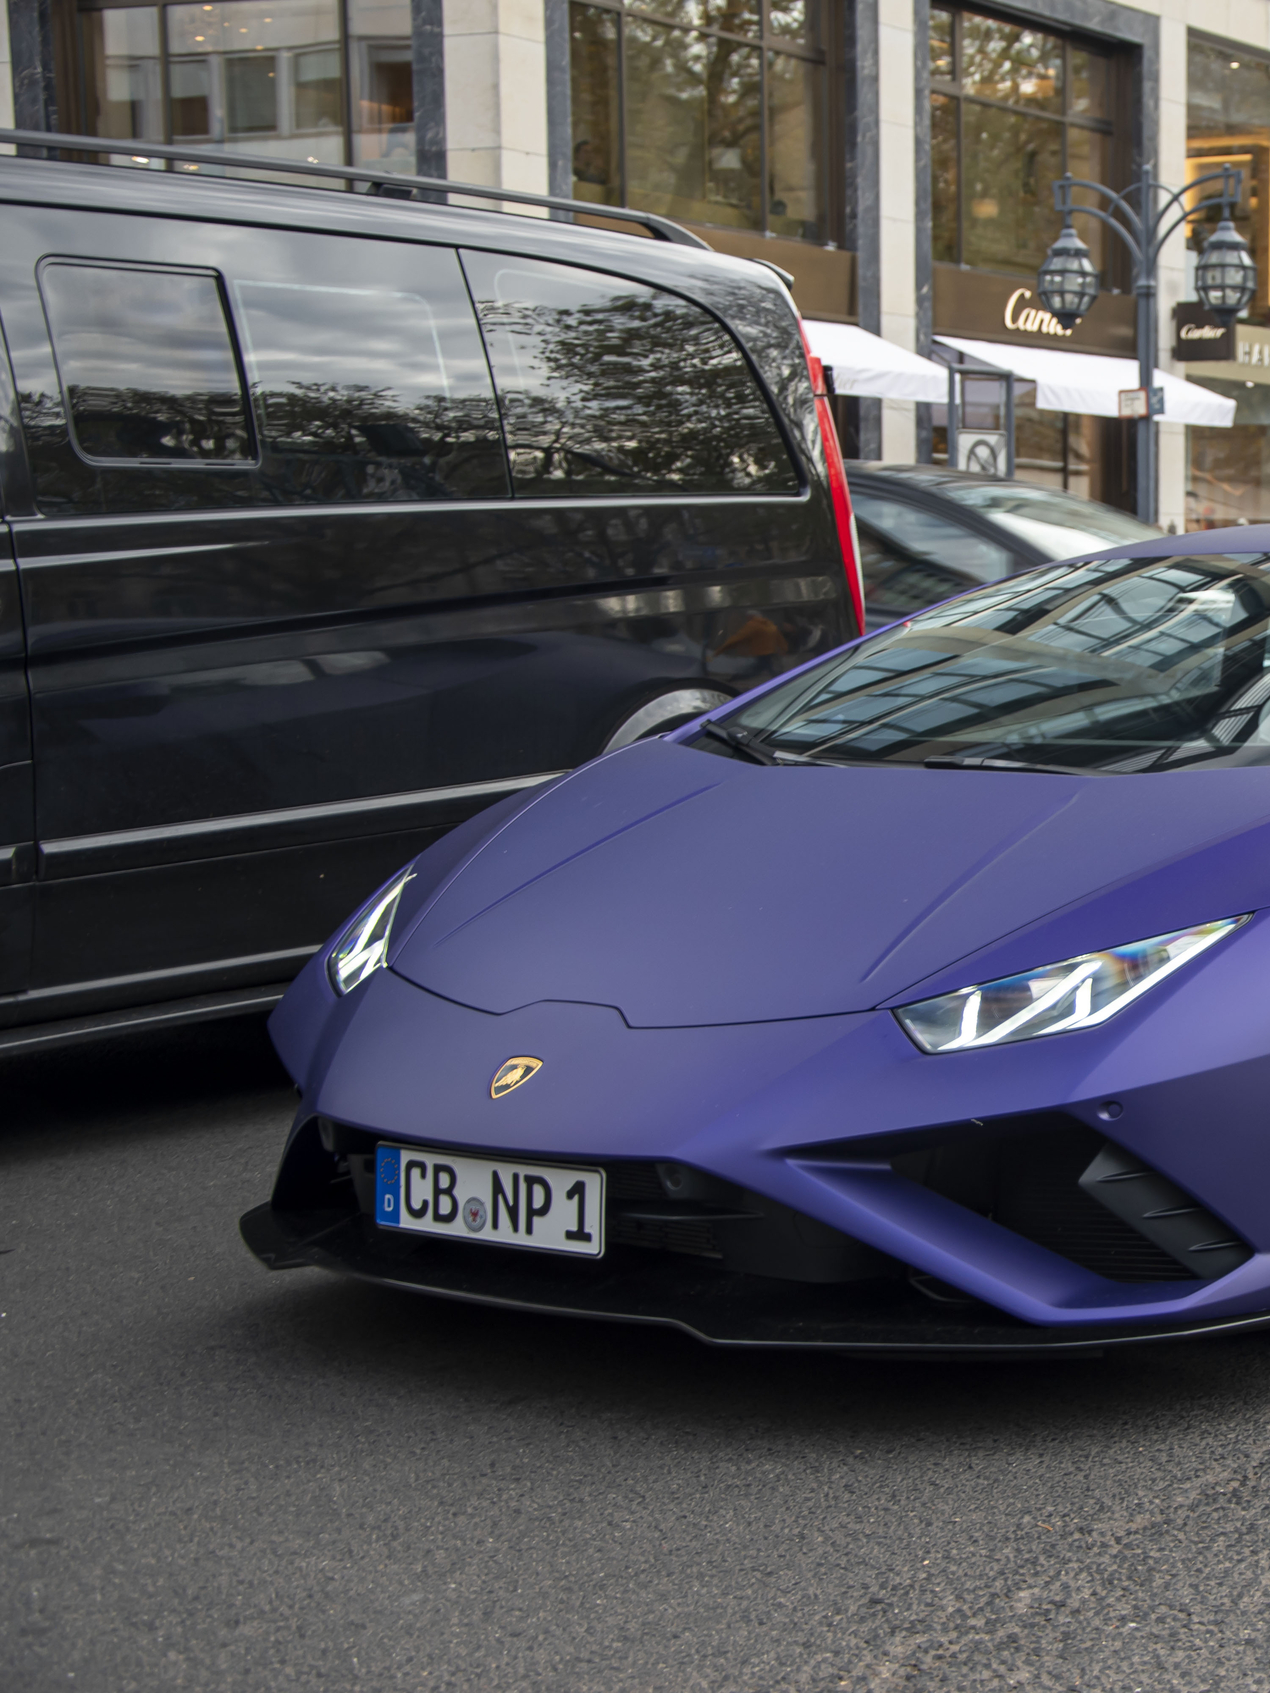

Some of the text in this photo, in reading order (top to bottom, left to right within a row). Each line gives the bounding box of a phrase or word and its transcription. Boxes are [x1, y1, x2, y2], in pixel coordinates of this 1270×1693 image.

[1180, 323, 1226, 340] Cartier
[384, 1193, 394, 1212] D
[404, 1158, 593, 1243] CB NP 1
